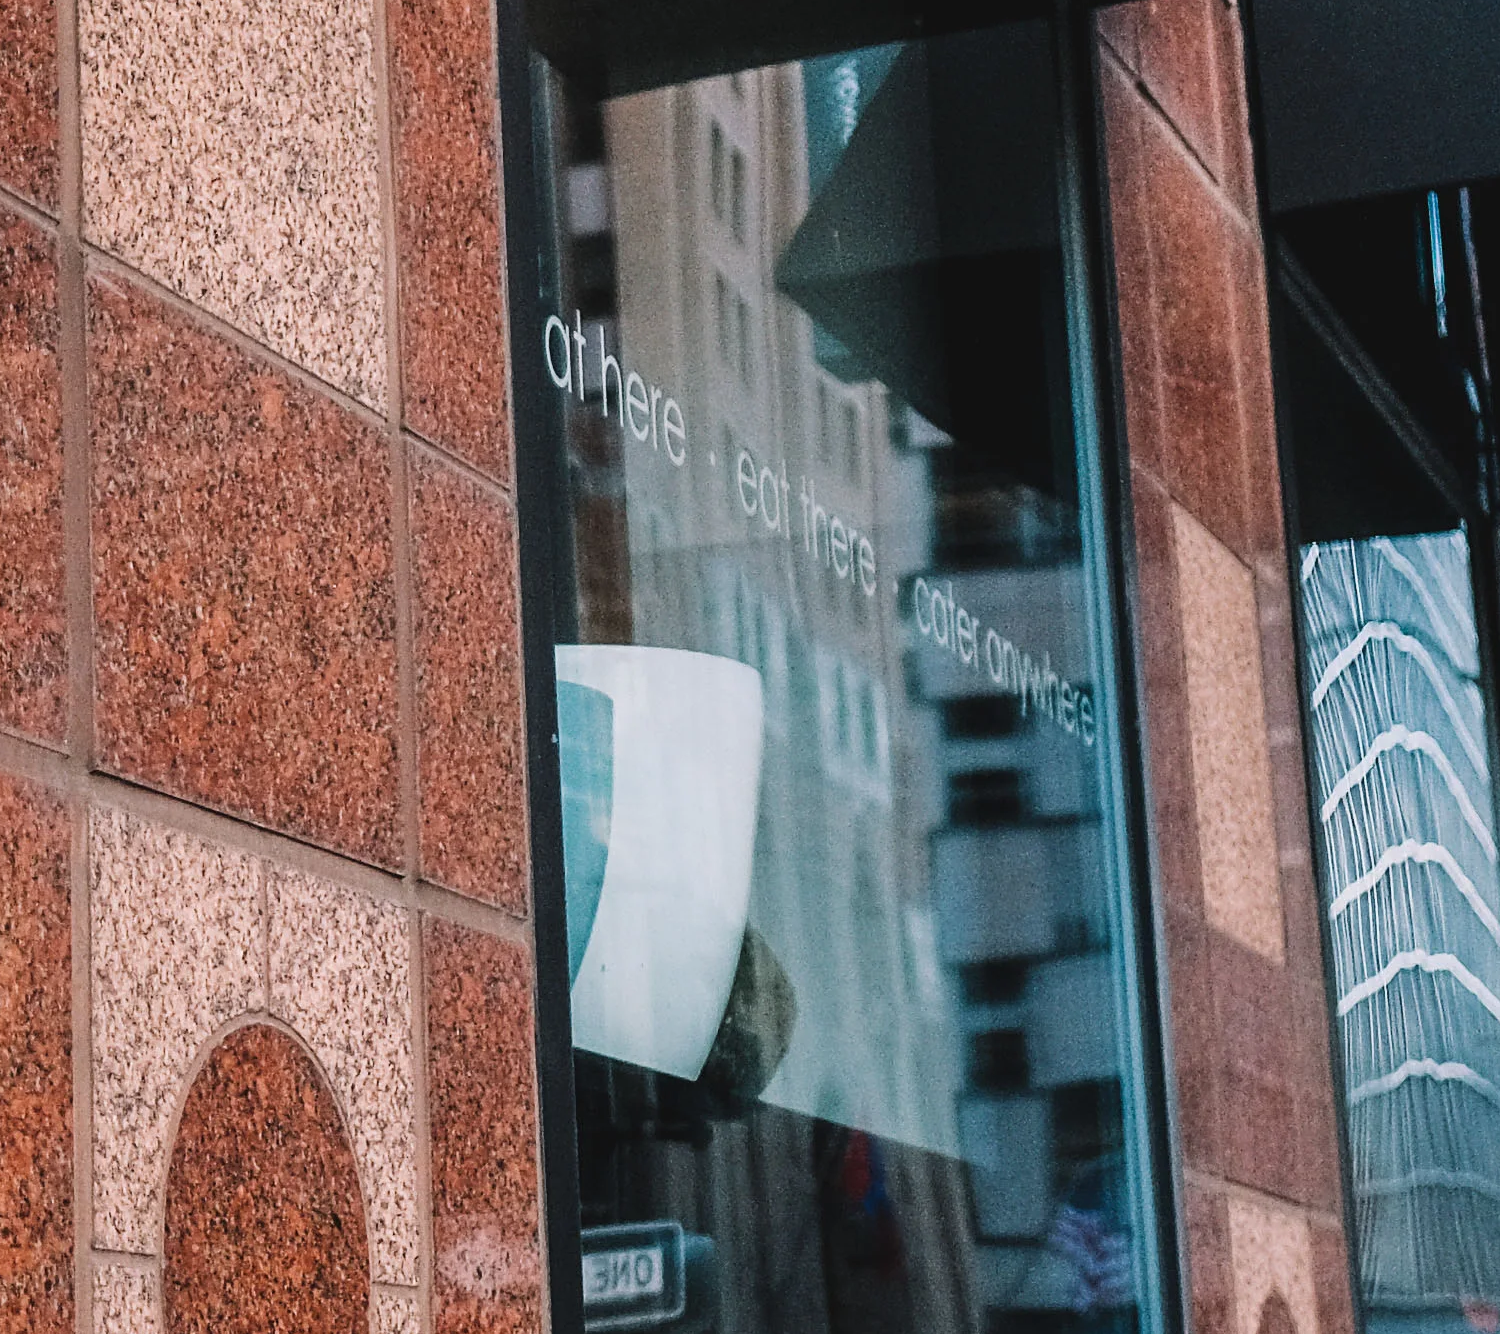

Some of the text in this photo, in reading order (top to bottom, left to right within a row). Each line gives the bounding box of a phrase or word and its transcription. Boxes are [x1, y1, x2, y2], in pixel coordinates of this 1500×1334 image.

[545, 308, 1096, 748] at here eat there cater anywhere
